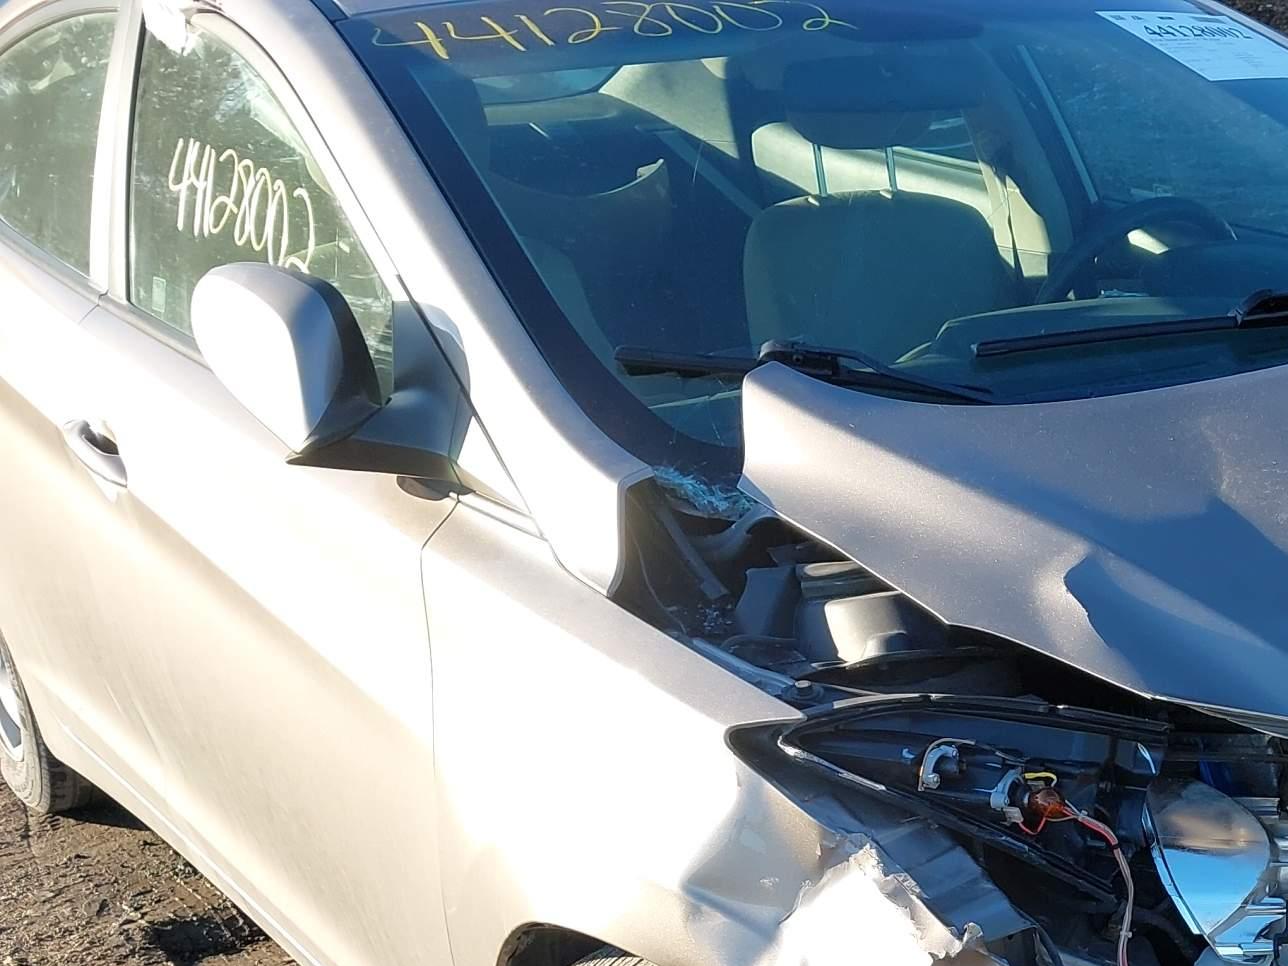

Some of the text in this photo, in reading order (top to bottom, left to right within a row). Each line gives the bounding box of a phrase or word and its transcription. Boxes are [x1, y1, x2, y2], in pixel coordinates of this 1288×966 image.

[371, 1, 859, 60] 44128002
[1143, 24, 1254, 40] 44128002
[168, 137, 316, 274] 44128002
